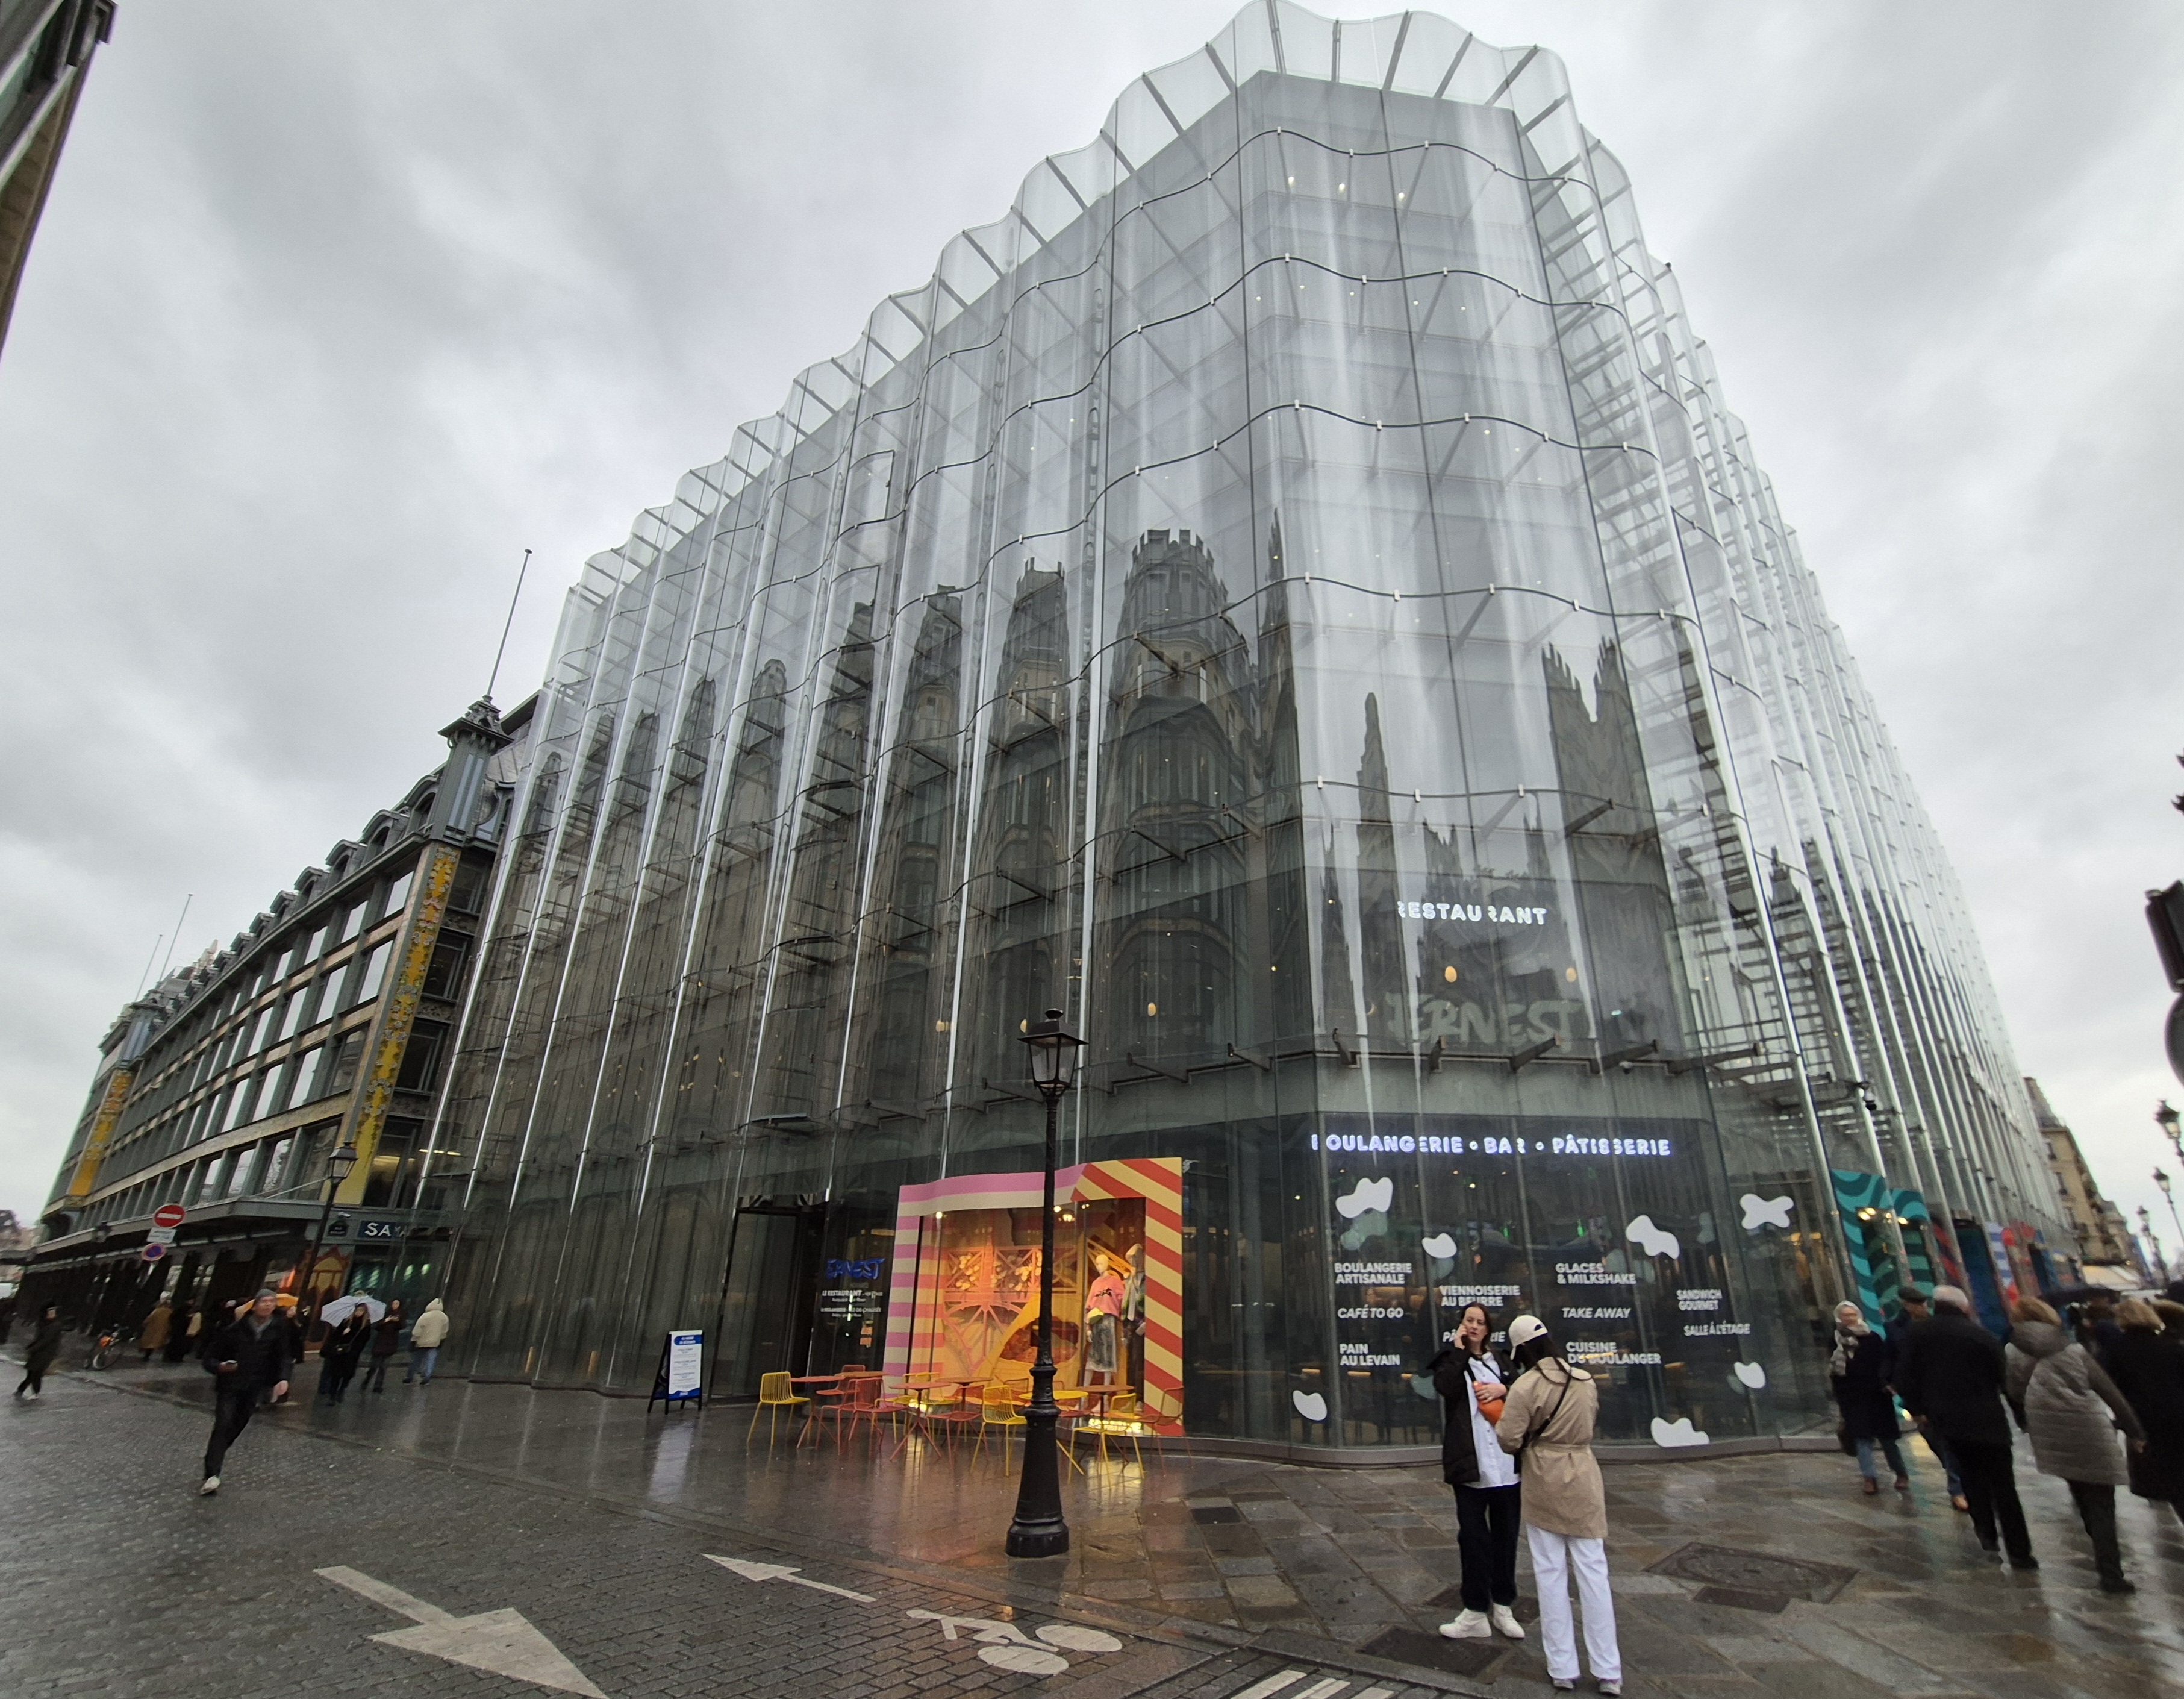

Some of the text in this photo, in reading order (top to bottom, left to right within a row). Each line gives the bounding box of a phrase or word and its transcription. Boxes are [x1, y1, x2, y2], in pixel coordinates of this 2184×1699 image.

[1385, 993, 1585, 1052] ERNEST
[1334, 1262, 1412, 1273] BOULANGERIE
[1555, 1263, 1604, 1273] GLACES
[1335, 1274, 1405, 1284] ARTISANALE
[1557, 1273, 1636, 1284] & MILKSHAKE
[1439, 1285, 1520, 1296] VIENNOISERIE
[1441, 1297, 1456, 1306] AU
[1337, 1304, 1404, 1318] CAFÉ TO GO
[1561, 1307, 1631, 1318] TAKE AWAY
[1683, 1324, 1709, 1336] SALLE
[1339, 1343, 1368, 1354] PAIN
[1566, 1342, 1617, 1352] CUISINE
[1340, 1354, 1400, 1366] AU LEVAIN
